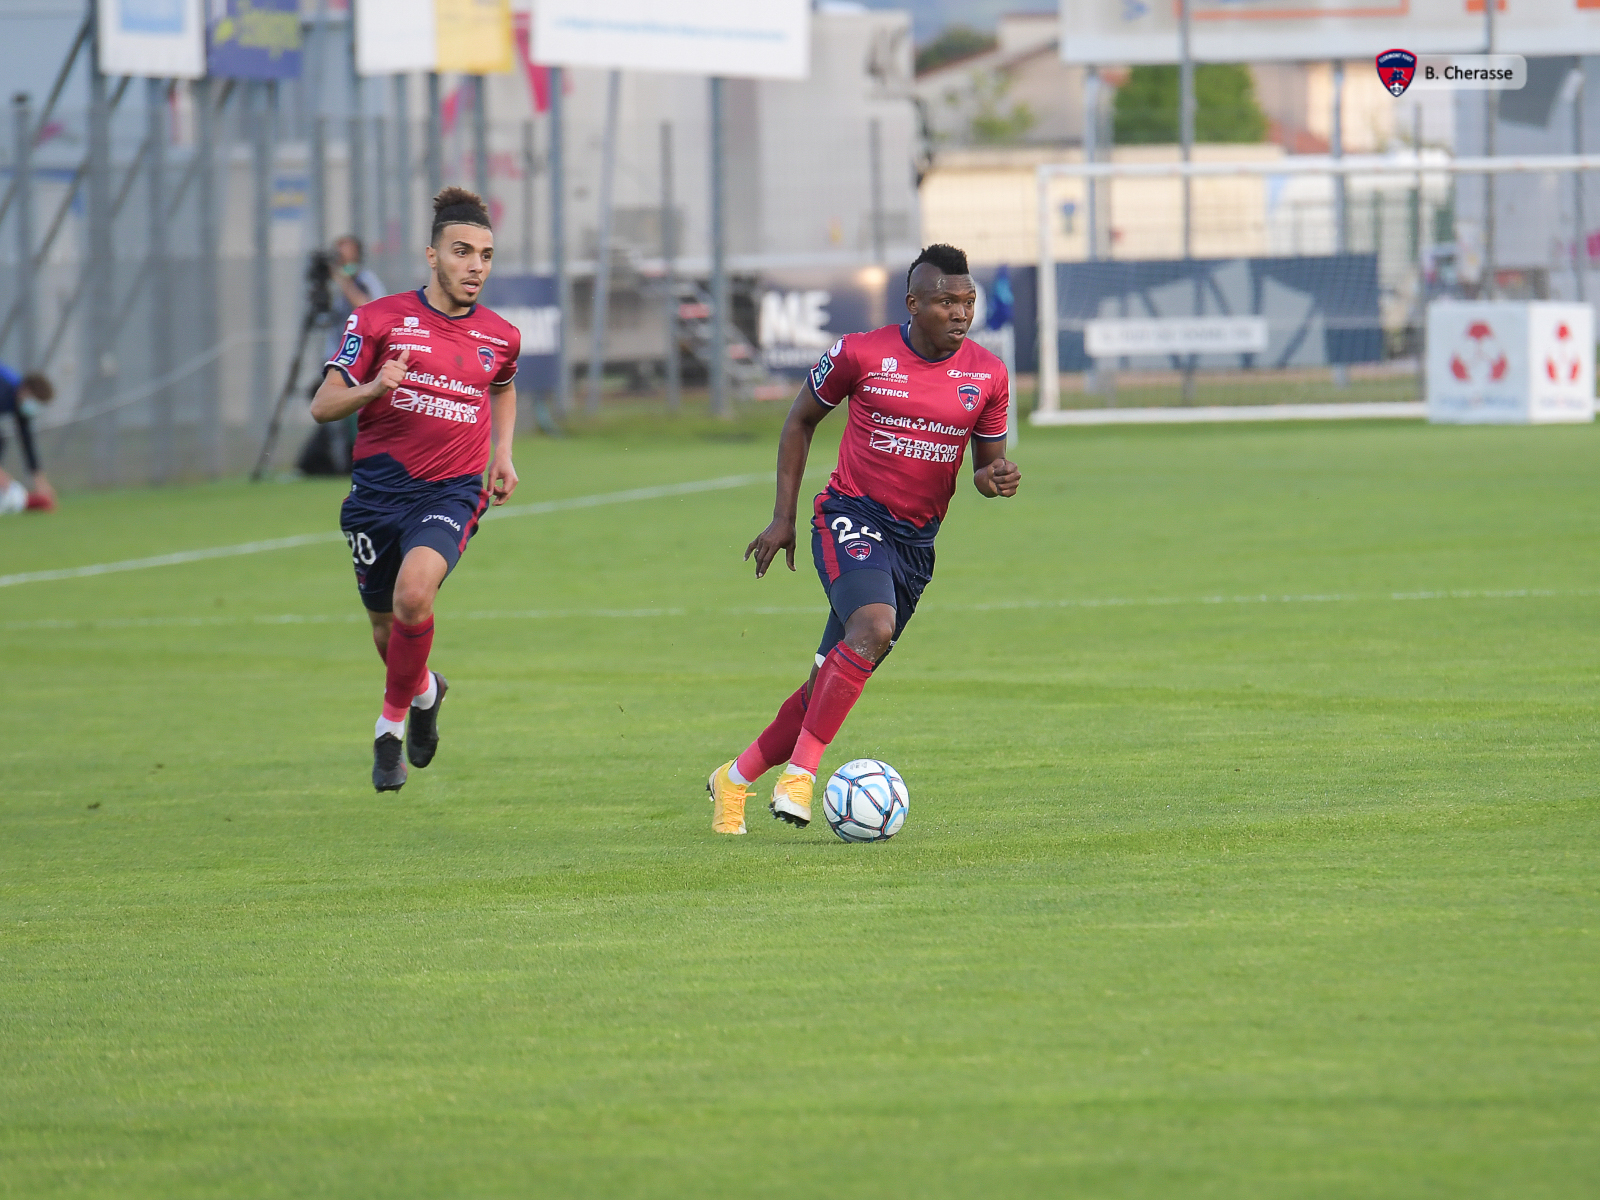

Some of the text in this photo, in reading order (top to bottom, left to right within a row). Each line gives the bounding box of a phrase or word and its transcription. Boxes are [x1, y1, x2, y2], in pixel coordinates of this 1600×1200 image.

[396, 343, 432, 353] PATRICK
[404, 371, 435, 386] rédit
[963, 371, 991, 379] HYUNDAI
[871, 386, 910, 398] PATRICK
[419, 394, 481, 415] CLERMONT
[416, 403, 478, 424] FERRAND
[871, 412, 969, 437] Crédit Mutuel
[897, 437, 959, 454] CLERMONT
[895, 446, 957, 463] FERRAND
[433, 514, 461, 532] VEOLIA
